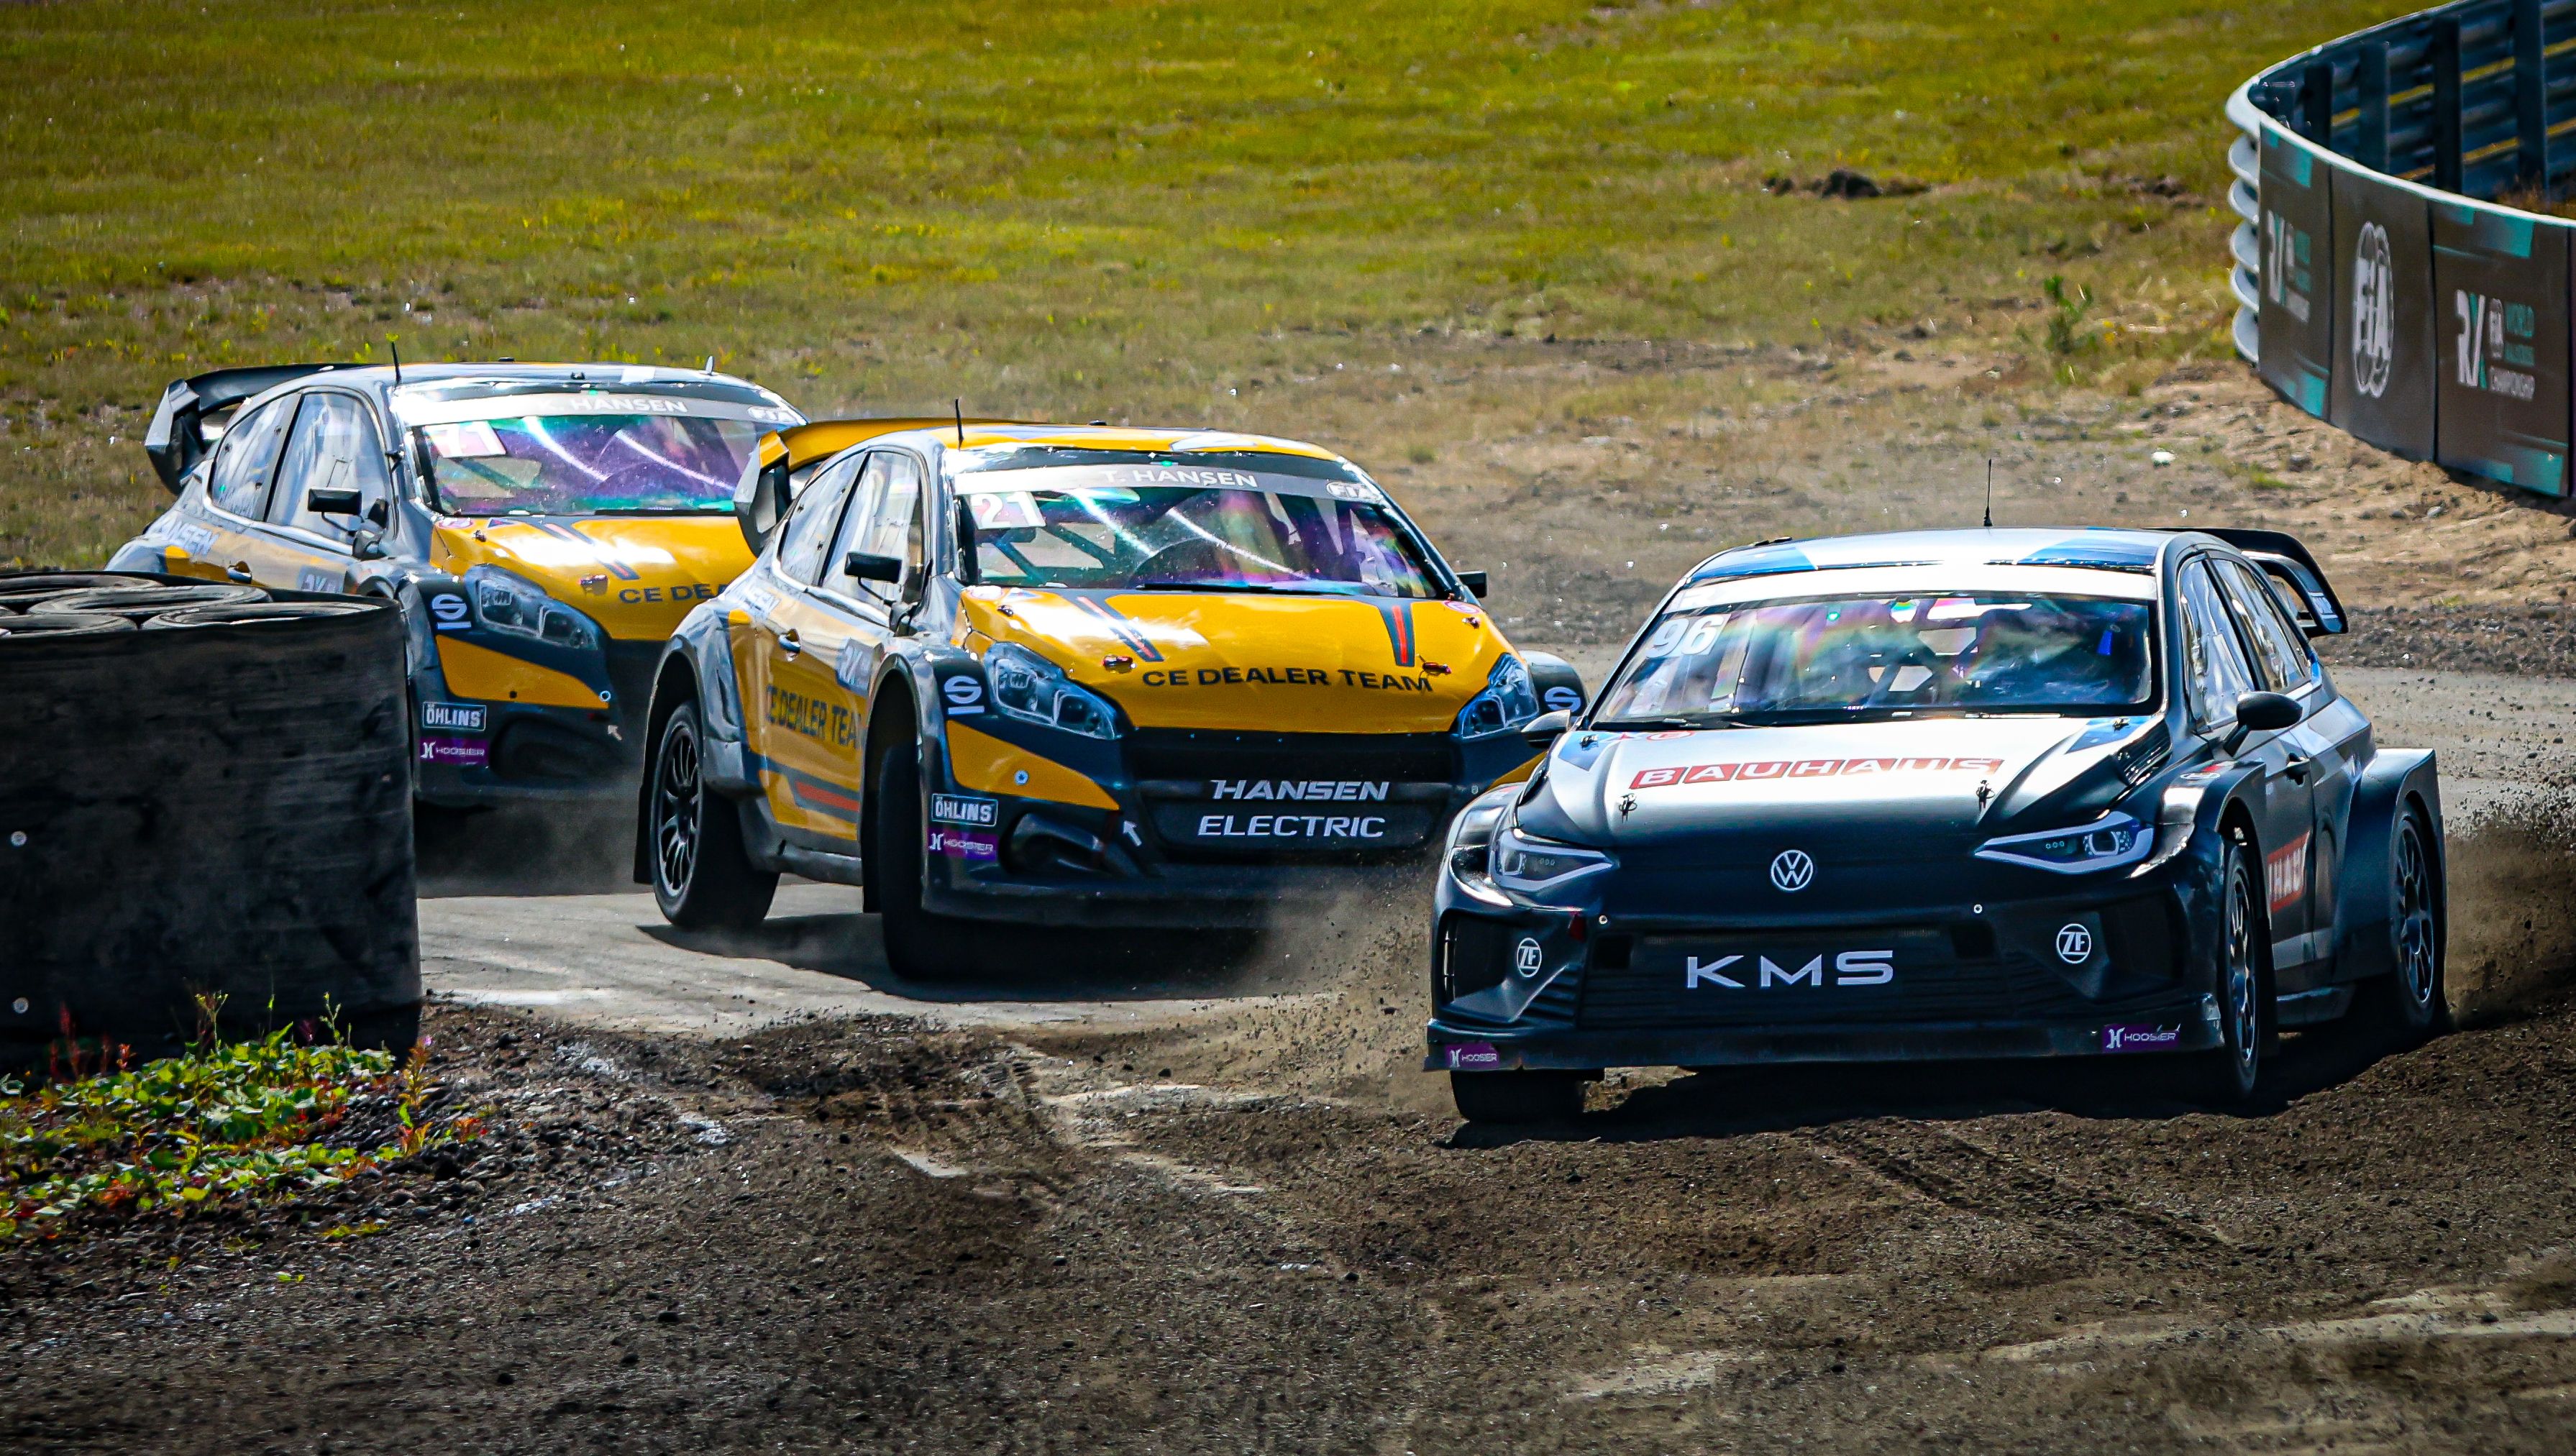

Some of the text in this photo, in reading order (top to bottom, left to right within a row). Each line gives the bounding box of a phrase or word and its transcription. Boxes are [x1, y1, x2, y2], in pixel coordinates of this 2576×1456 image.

[570, 398, 688, 413] HANSEN
[1103, 469, 1259, 488] T. HANSEN
[971, 491, 1035, 528] 21
[618, 587, 664, 604] CE
[1647, 614, 1728, 659] 96
[1142, 667, 1433, 692] CE DEALER TEAM
[426, 704, 483, 727] ÖHLINS
[779, 689, 827, 741] DEALER
[1636, 758, 1996, 787] BAUHAUS
[1210, 779, 1390, 801] HANSEN
[935, 796, 992, 823] ÖHLINS
[1197, 815, 1387, 838] ELECTRIC
[1518, 942, 1541, 972] ZF
[2058, 928, 2090, 960] ZF
[1686, 950, 1894, 989] KMS
[2124, 1033, 2176, 1041] HOOSIER
